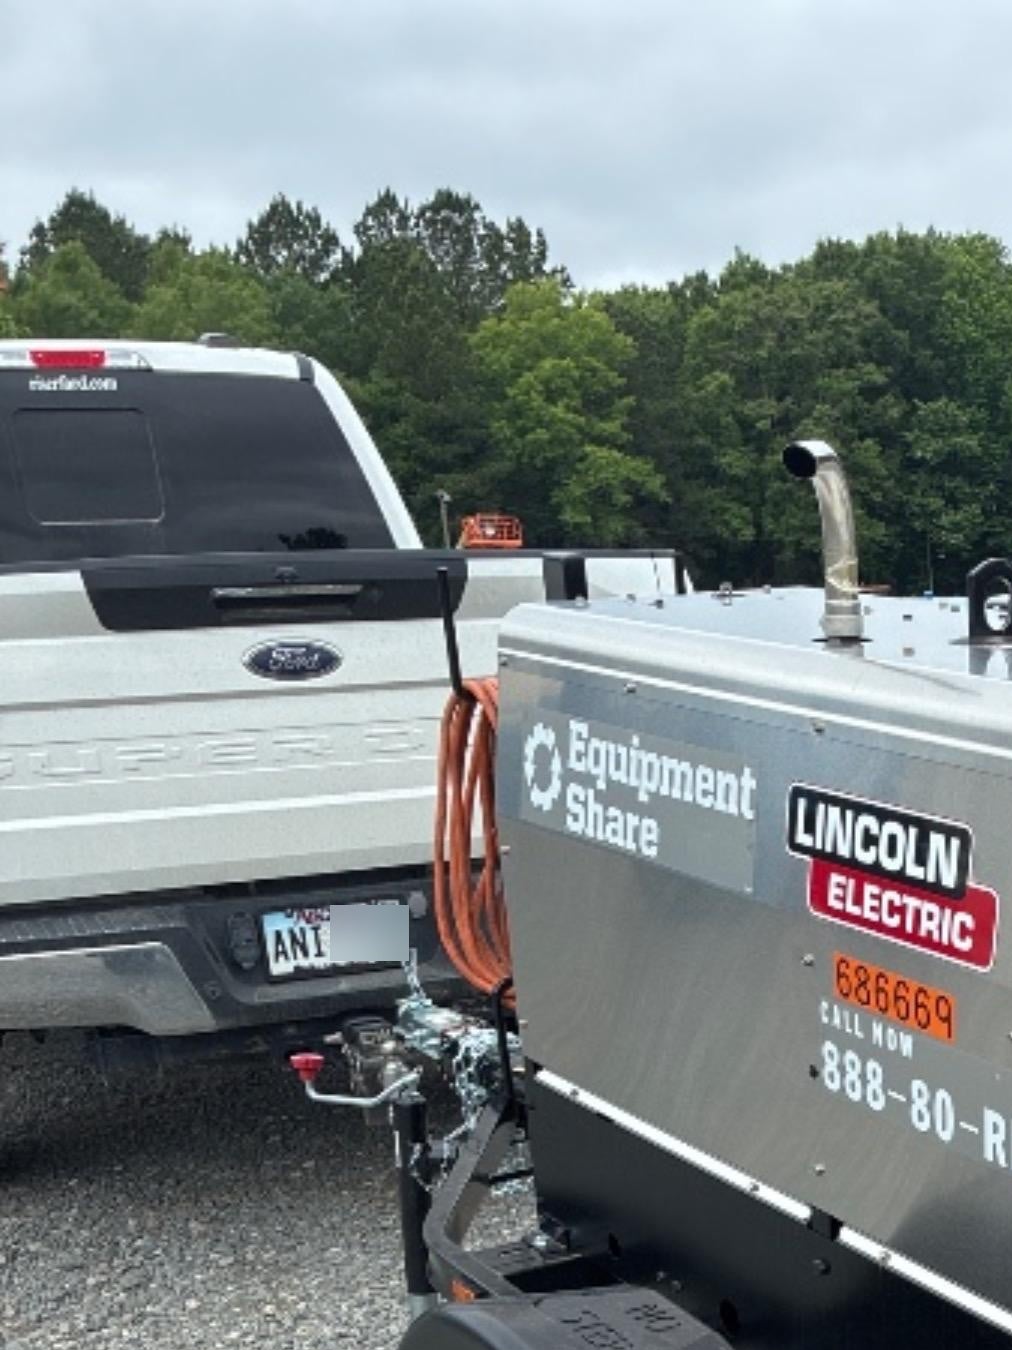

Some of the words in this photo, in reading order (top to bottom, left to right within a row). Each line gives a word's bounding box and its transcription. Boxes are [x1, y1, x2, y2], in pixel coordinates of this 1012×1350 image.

[269, 646, 319, 670] Ford
[567, 718, 757, 820] Equipment
[565, 782, 658, 858] Share
[795, 797, 961, 889] LINCOLN
[827, 872, 976, 952] ELECTRIC
[820, 1000, 864, 1039] CALL
[872, 1019, 913, 1059] NOW
[836, 958, 953, 1038] 686669
